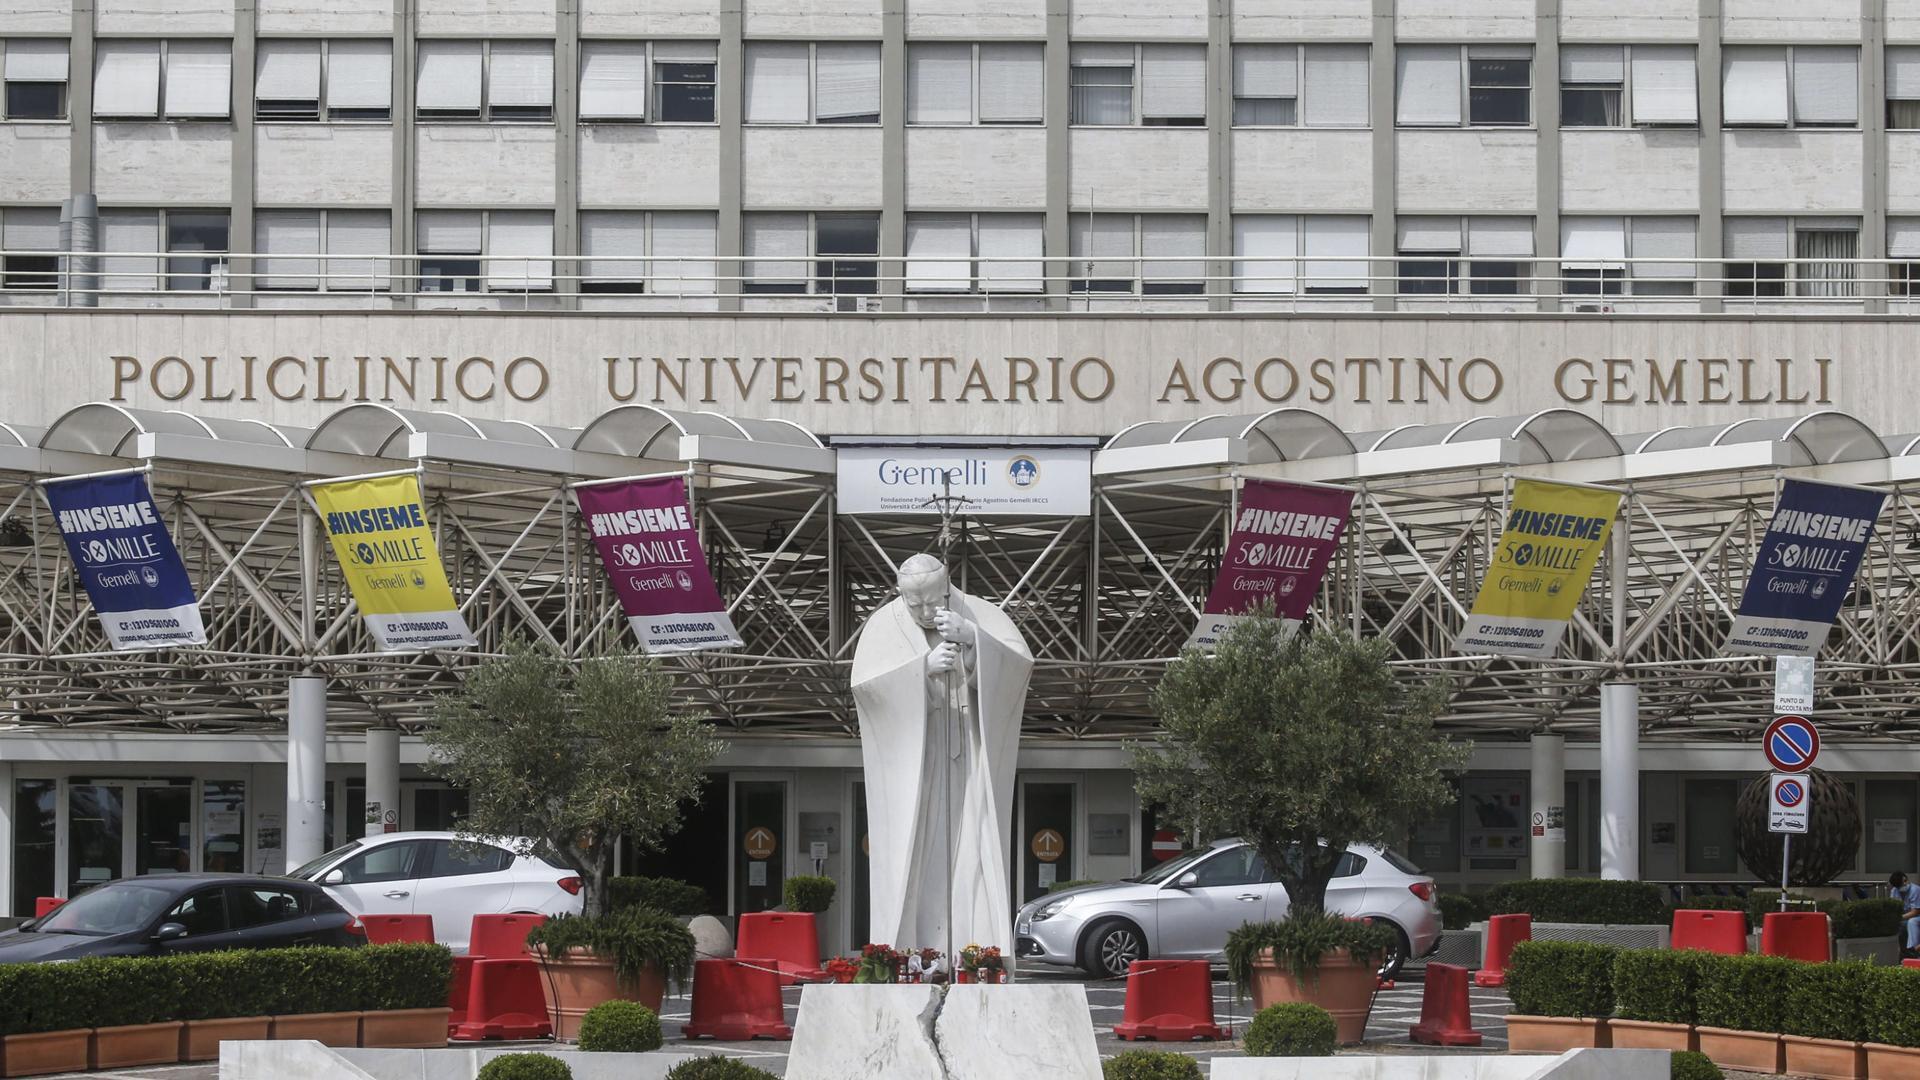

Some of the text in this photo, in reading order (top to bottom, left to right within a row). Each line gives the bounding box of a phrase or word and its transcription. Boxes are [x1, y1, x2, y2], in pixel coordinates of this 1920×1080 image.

[110, 356, 1833, 405] POLICLINICO UNIVERSITARIO AGOSTINO GEMELLI
[878, 459, 988, 486] Gemelli
[59, 501, 157, 534] #INSIEME
[327, 503, 424, 535] #INSIEME
[590, 505, 690, 537] #INSIEME
[1237, 508, 1341, 541] #INSIEME
[1505, 509, 1607, 541] #INSIEME
[1770, 509, 1872, 543] #INSIEME
[98, 569, 141, 588] Gemelli
[366, 574, 407, 590] Gemelli
[629, 573, 675, 592] Gemelli
[1233, 575, 1276, 592] Gemelli
[1498, 575, 1543, 593] Gemelli
[1767, 576, 1809, 594] Gemelli
[1775, 704, 1802, 712] RACCOLTA
